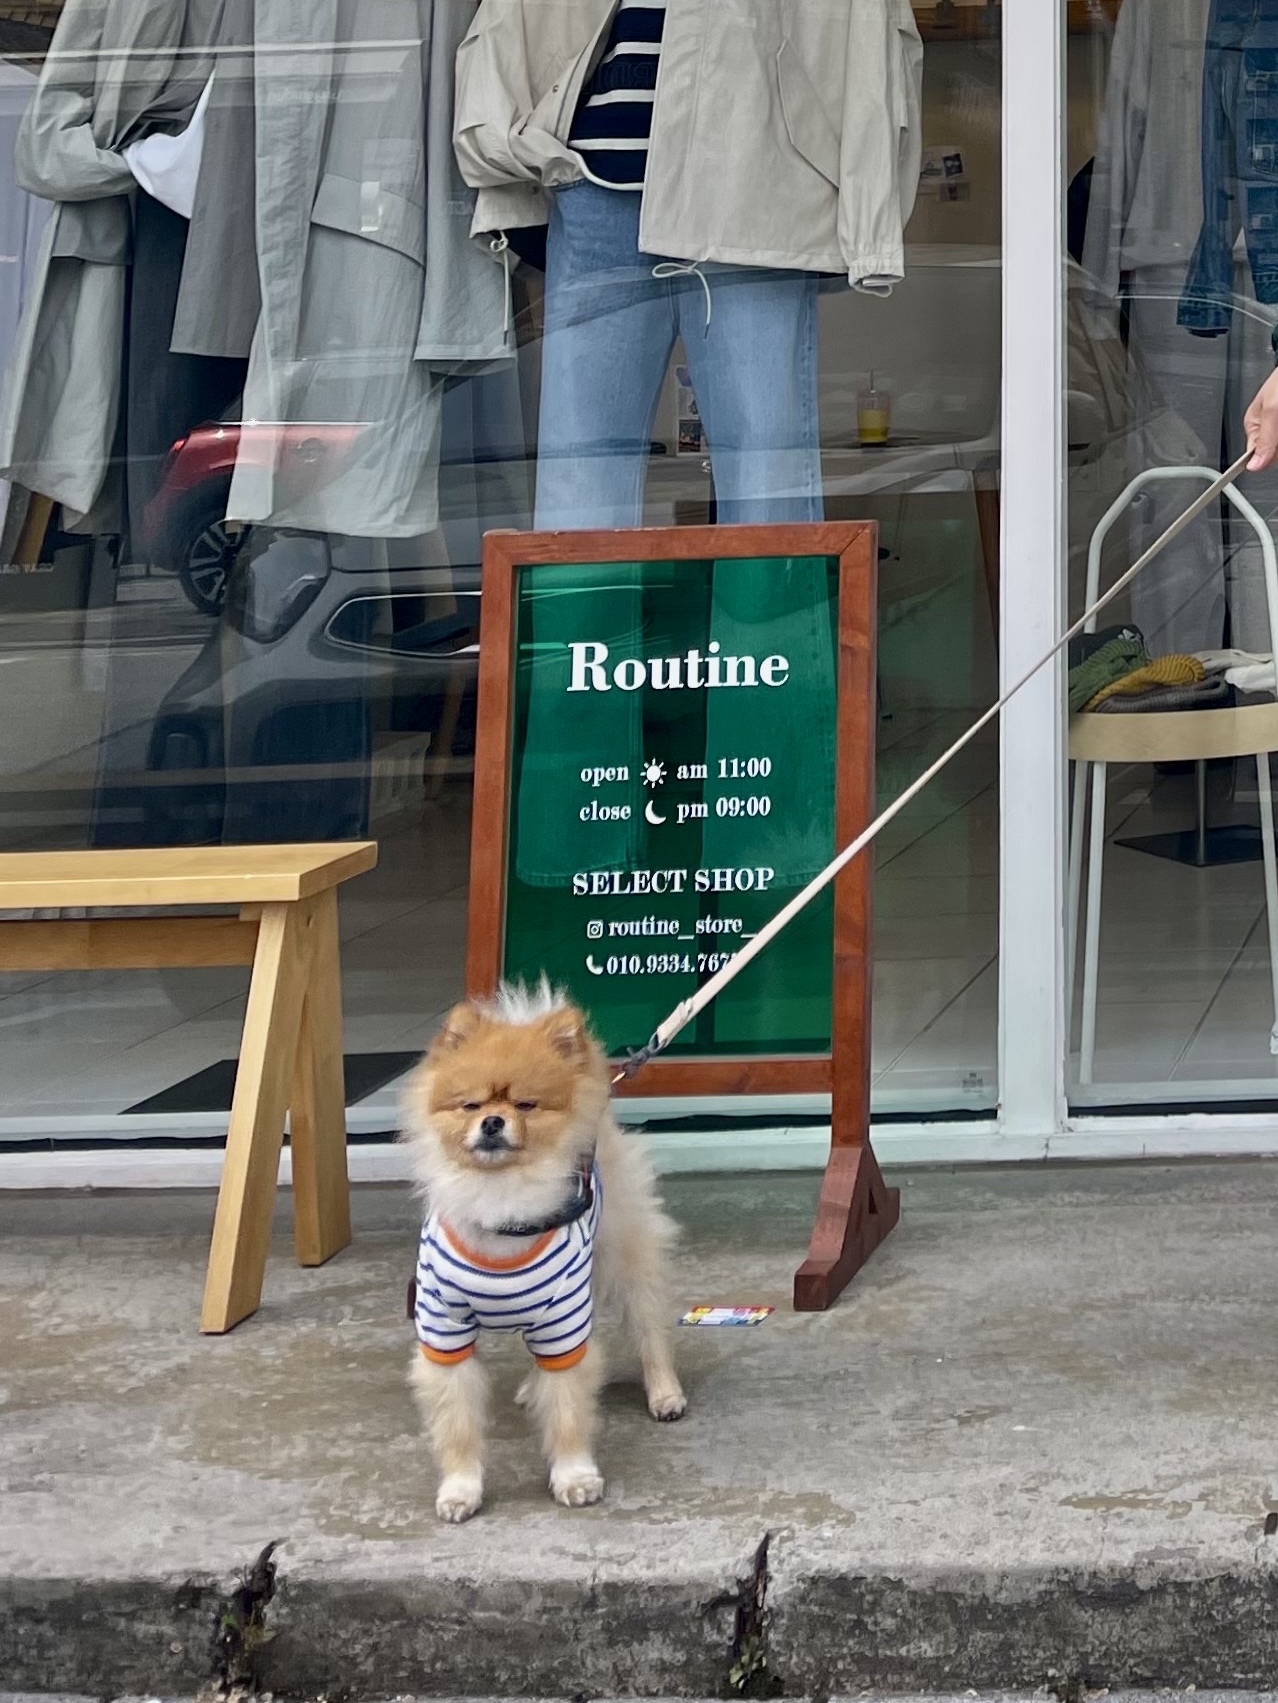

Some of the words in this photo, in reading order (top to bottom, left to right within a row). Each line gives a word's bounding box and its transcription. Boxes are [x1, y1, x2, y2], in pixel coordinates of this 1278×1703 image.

[565, 641, 790, 692] Routine
[580, 765, 630, 787] open
[676, 763, 708, 780] am
[717, 757, 772, 779] 11:00
[579, 800, 632, 822] close
[676, 802, 709, 824] pm
[715, 796, 772, 818] 09:00
[572, 869, 687, 896] SELECT
[694, 867, 775, 893] SHOP
[606, 952, 738, 975] 010.9334.767
